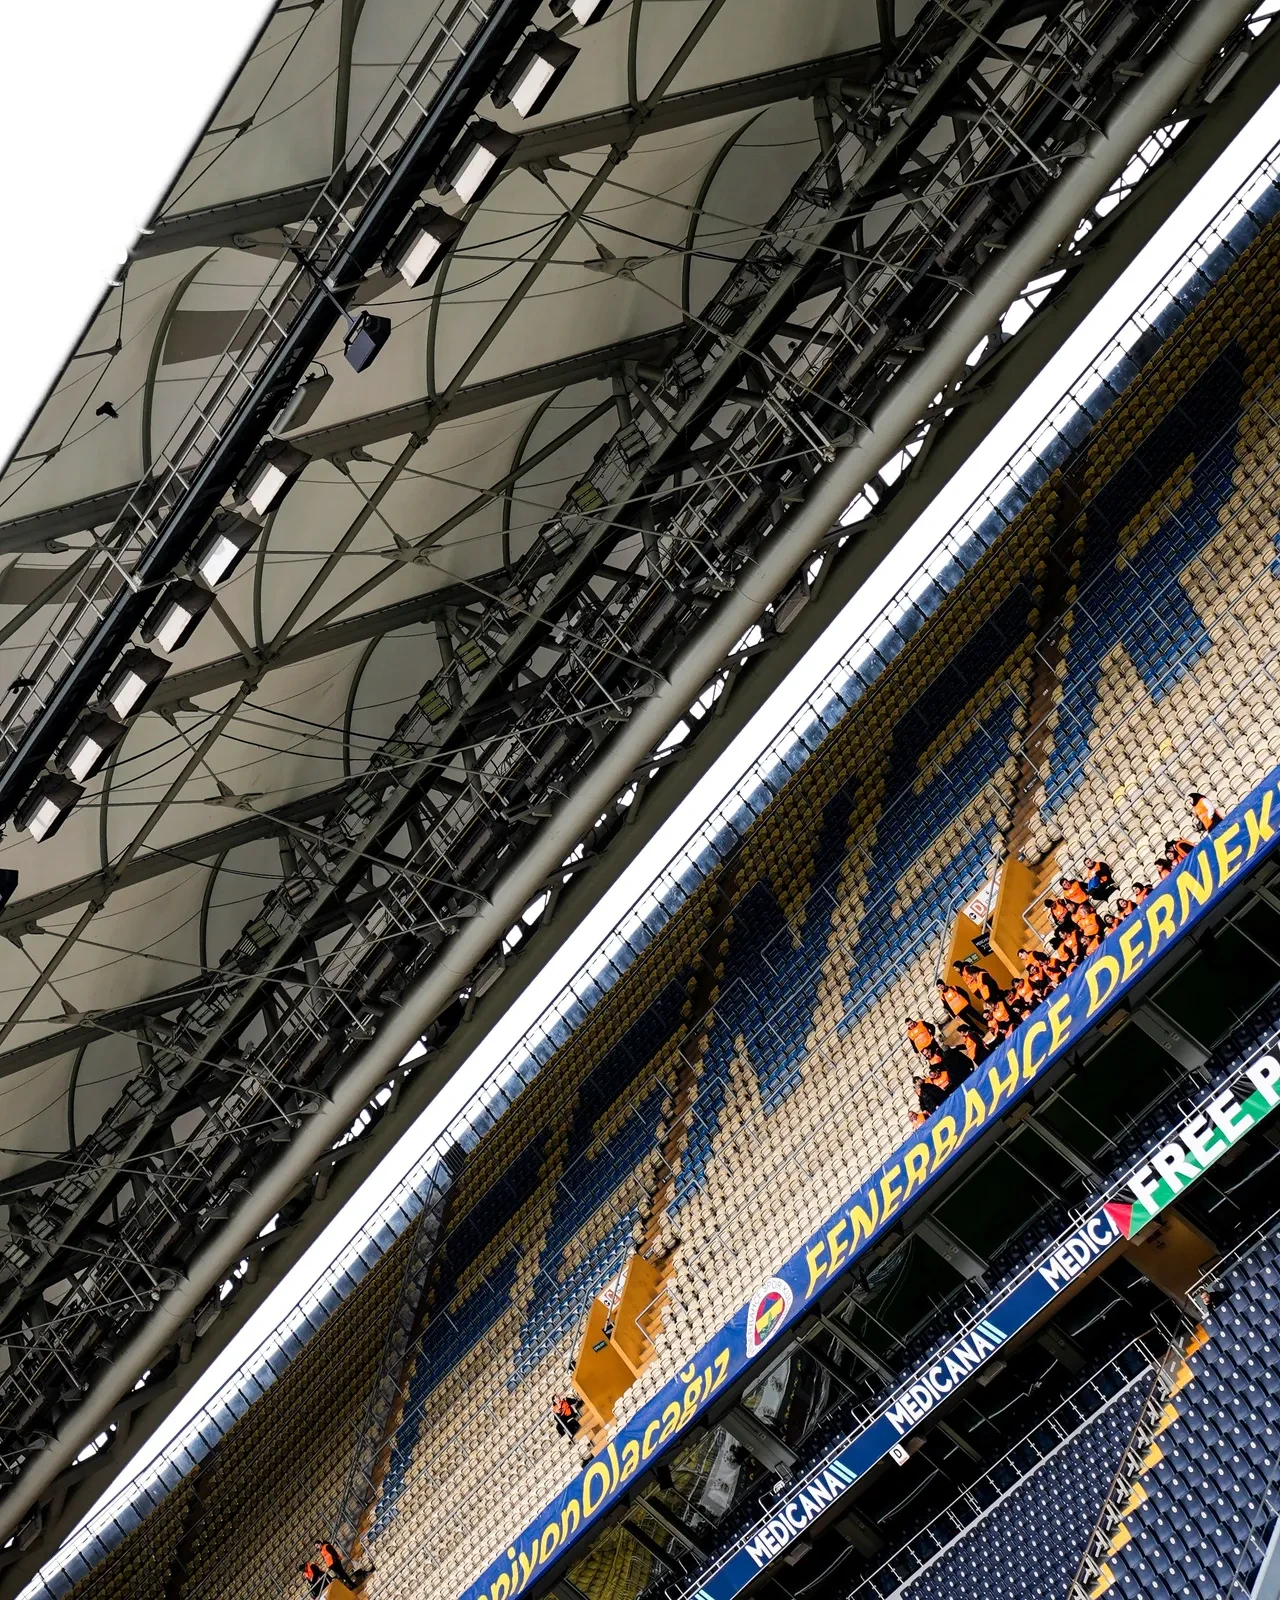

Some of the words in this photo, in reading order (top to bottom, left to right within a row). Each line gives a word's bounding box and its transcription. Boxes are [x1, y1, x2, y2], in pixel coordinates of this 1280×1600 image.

[1085, 780, 1280, 1017] DERNEK
[1126, 1088, 1255, 1216] FREE
[1245, 1042, 1280, 1107] P
[884, 1331, 996, 1435] MEDICANA
[477, 1347, 730, 1600] piyonOlacağız
[744, 1470, 846, 1568] MEDICANA
[893, 1448, 902, 1458] D
